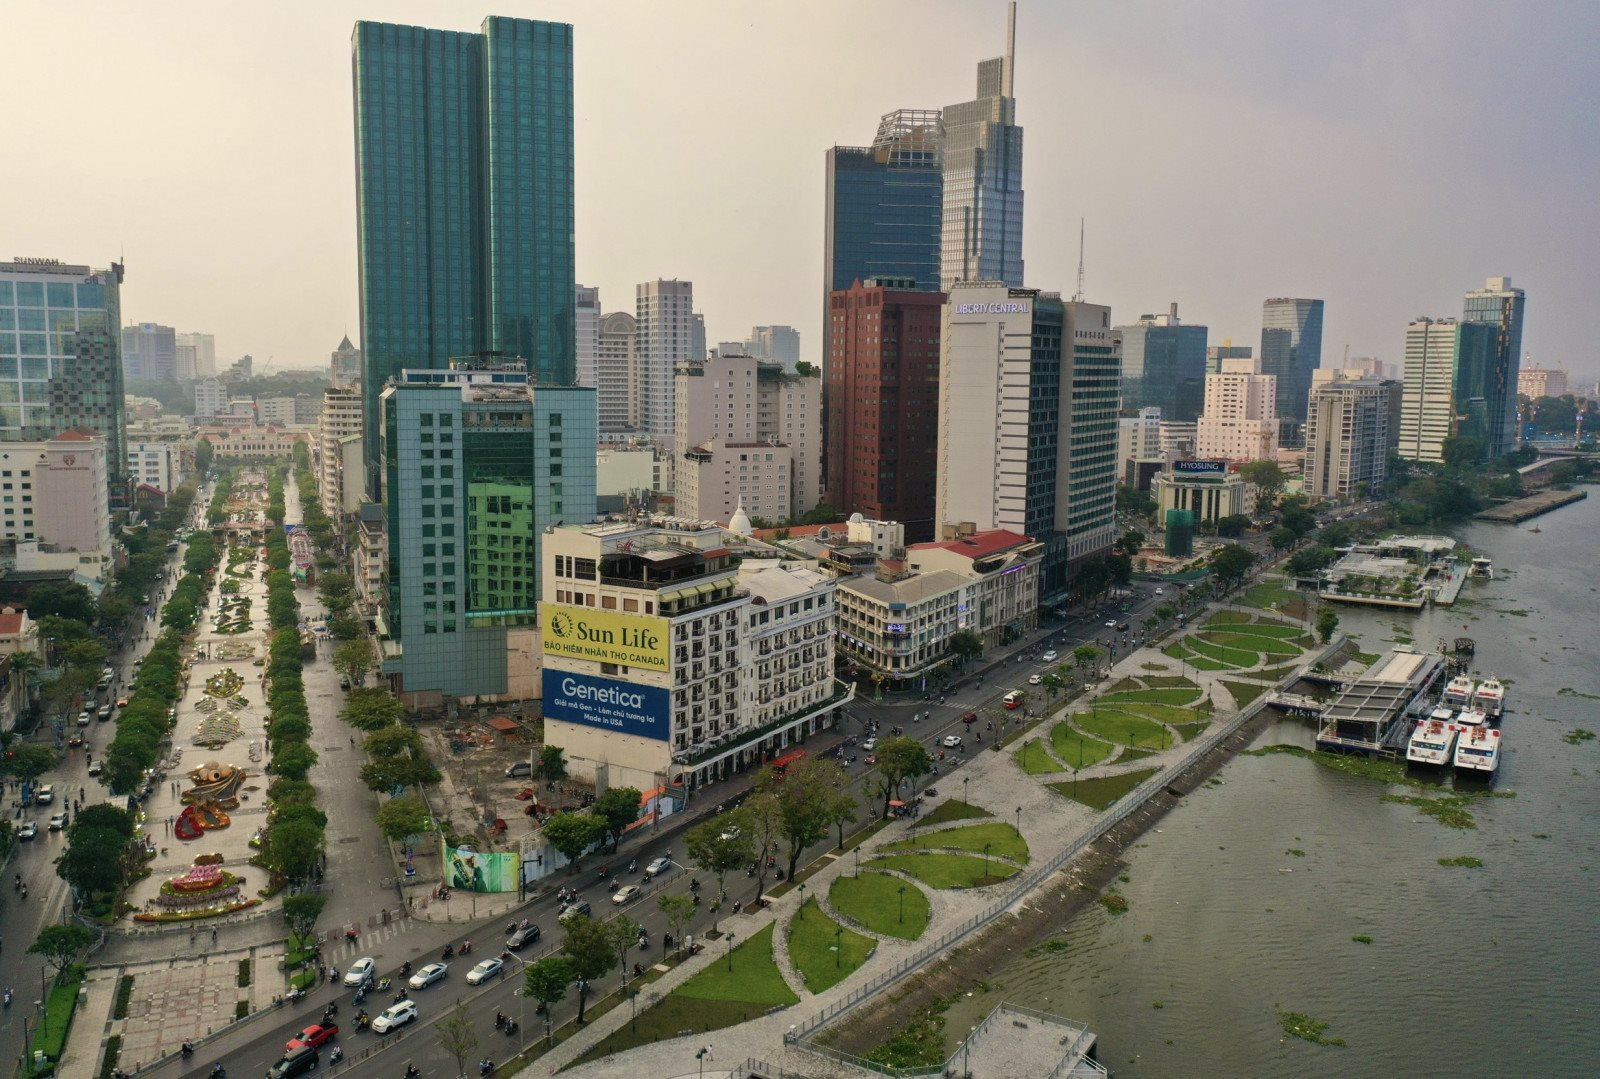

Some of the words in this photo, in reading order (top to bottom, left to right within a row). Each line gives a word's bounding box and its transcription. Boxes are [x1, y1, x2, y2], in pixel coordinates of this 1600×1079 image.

[955, 303, 988, 314] LIBERTY
[989, 303, 1028, 313] CENTRAL
[1180, 462, 1219, 470] HYOSUNG
[577, 621, 615, 645] Sun
[621, 627, 658, 650] Life
[585, 647, 608, 657] NHÂN
[629, 654, 666, 666] CANADA
[579, 703, 592, 711] Gen
[584, 713, 602, 722] Made
[610, 719, 623, 727] USA
